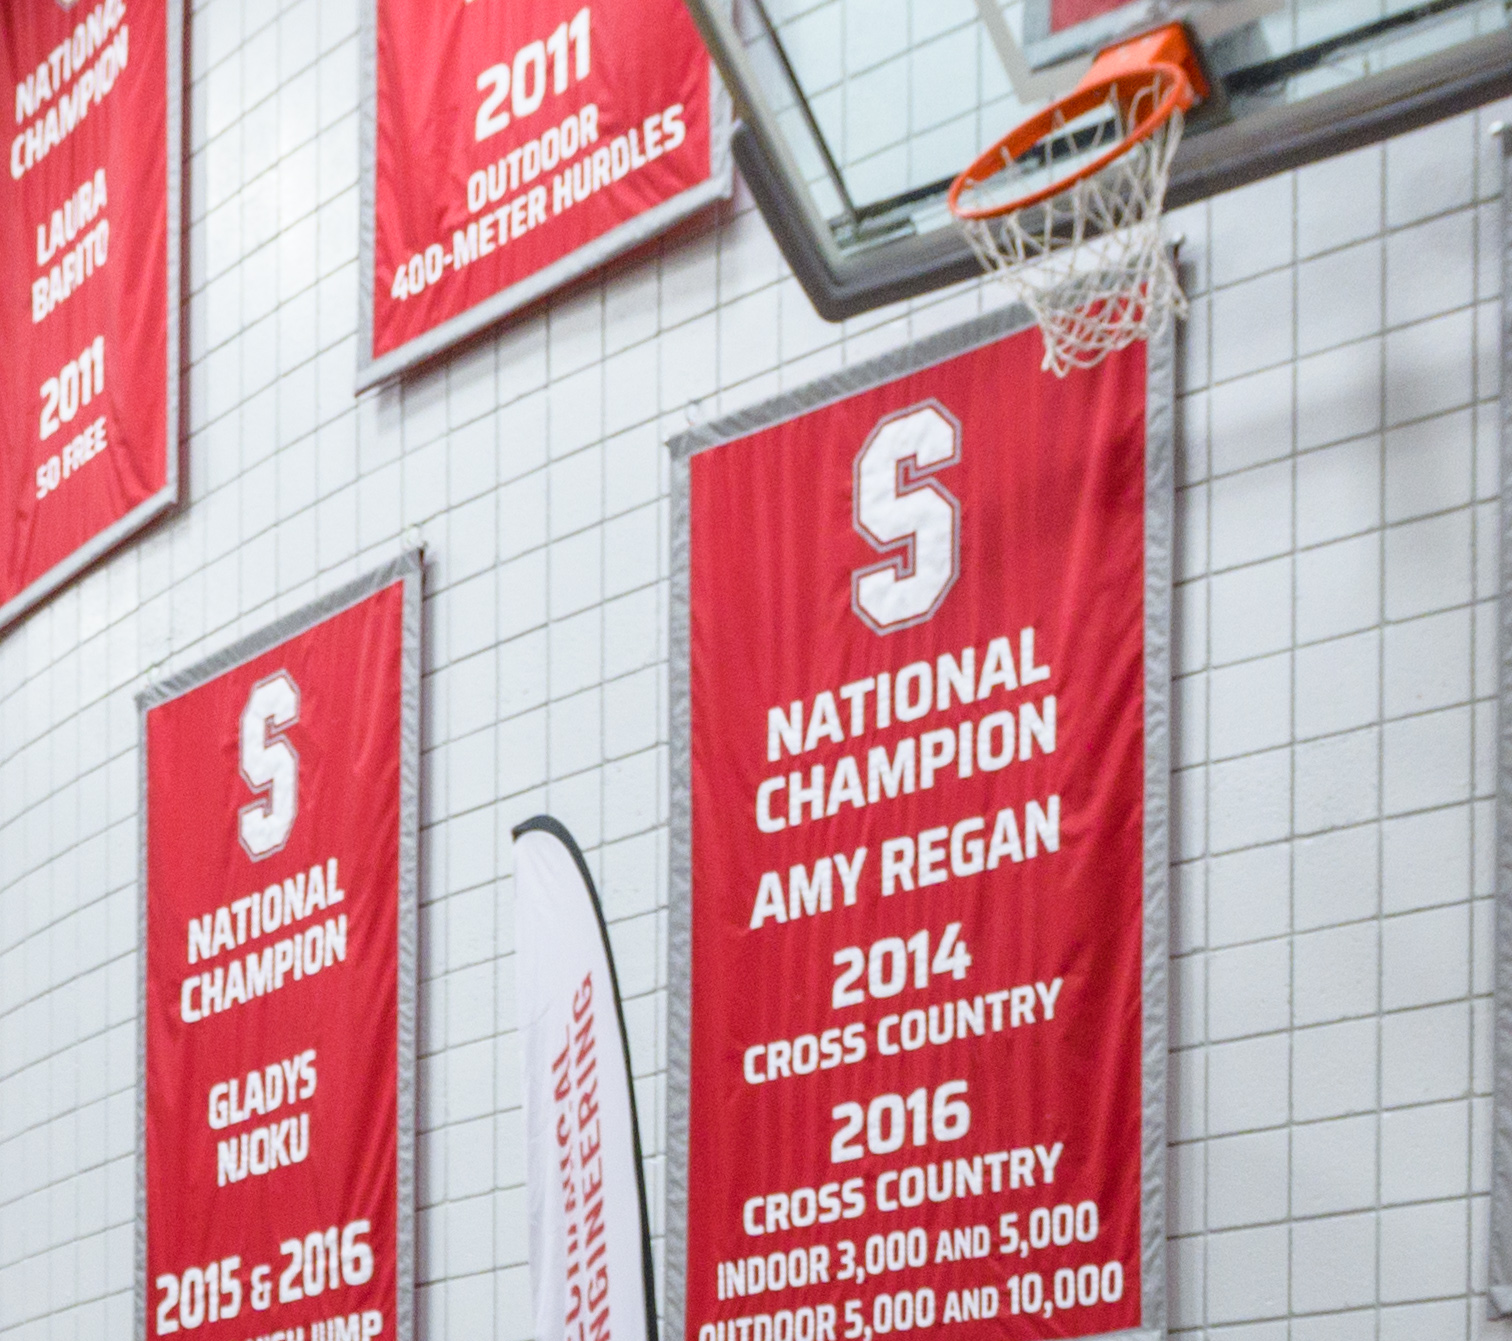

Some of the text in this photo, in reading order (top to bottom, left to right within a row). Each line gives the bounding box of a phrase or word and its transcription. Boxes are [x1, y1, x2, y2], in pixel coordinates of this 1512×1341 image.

[10, 25, 129, 180] CHAMPION
[15, 0, 127, 125] NATIONA
[476, 15, 592, 142] 2011
[391, 103, 687, 302] 400-METER HURDLES
[466, 103, 600, 213] OUTDOOR
[36, 168, 108, 267] LAURA
[39, 335, 106, 442] 2011
[35, 416, 108, 499] 50 FREE
[850, 396, 962, 636] S
[766, 625, 1051, 762] NATIONAL
[237, 667, 301, 863] S
[754, 693, 1057, 834] CHAMPION
[186, 856, 345, 965] NATIONAL
[748, 793, 1060, 930] AMY REGAN
[179, 912, 348, 1023] CHAMPION
[830, 920, 972, 1009] 2014
[742, 976, 1063, 1085] CROSS COUNTRY
[207, 1047, 317, 1130] GLADYS
[829, 1078, 971, 1164] 2016
[216, 1111, 310, 1187] NJOKU
[742, 1141, 1063, 1236] CROSS COUNTRY
[155, 1218, 374, 1336] 2015 & 2016
[716, 1199, 1099, 1300] INDOOR 3,000 AND 5,000
[942, 1285, 999, 1324] AND
[1006, 1259, 1124, 1319] 10,000
